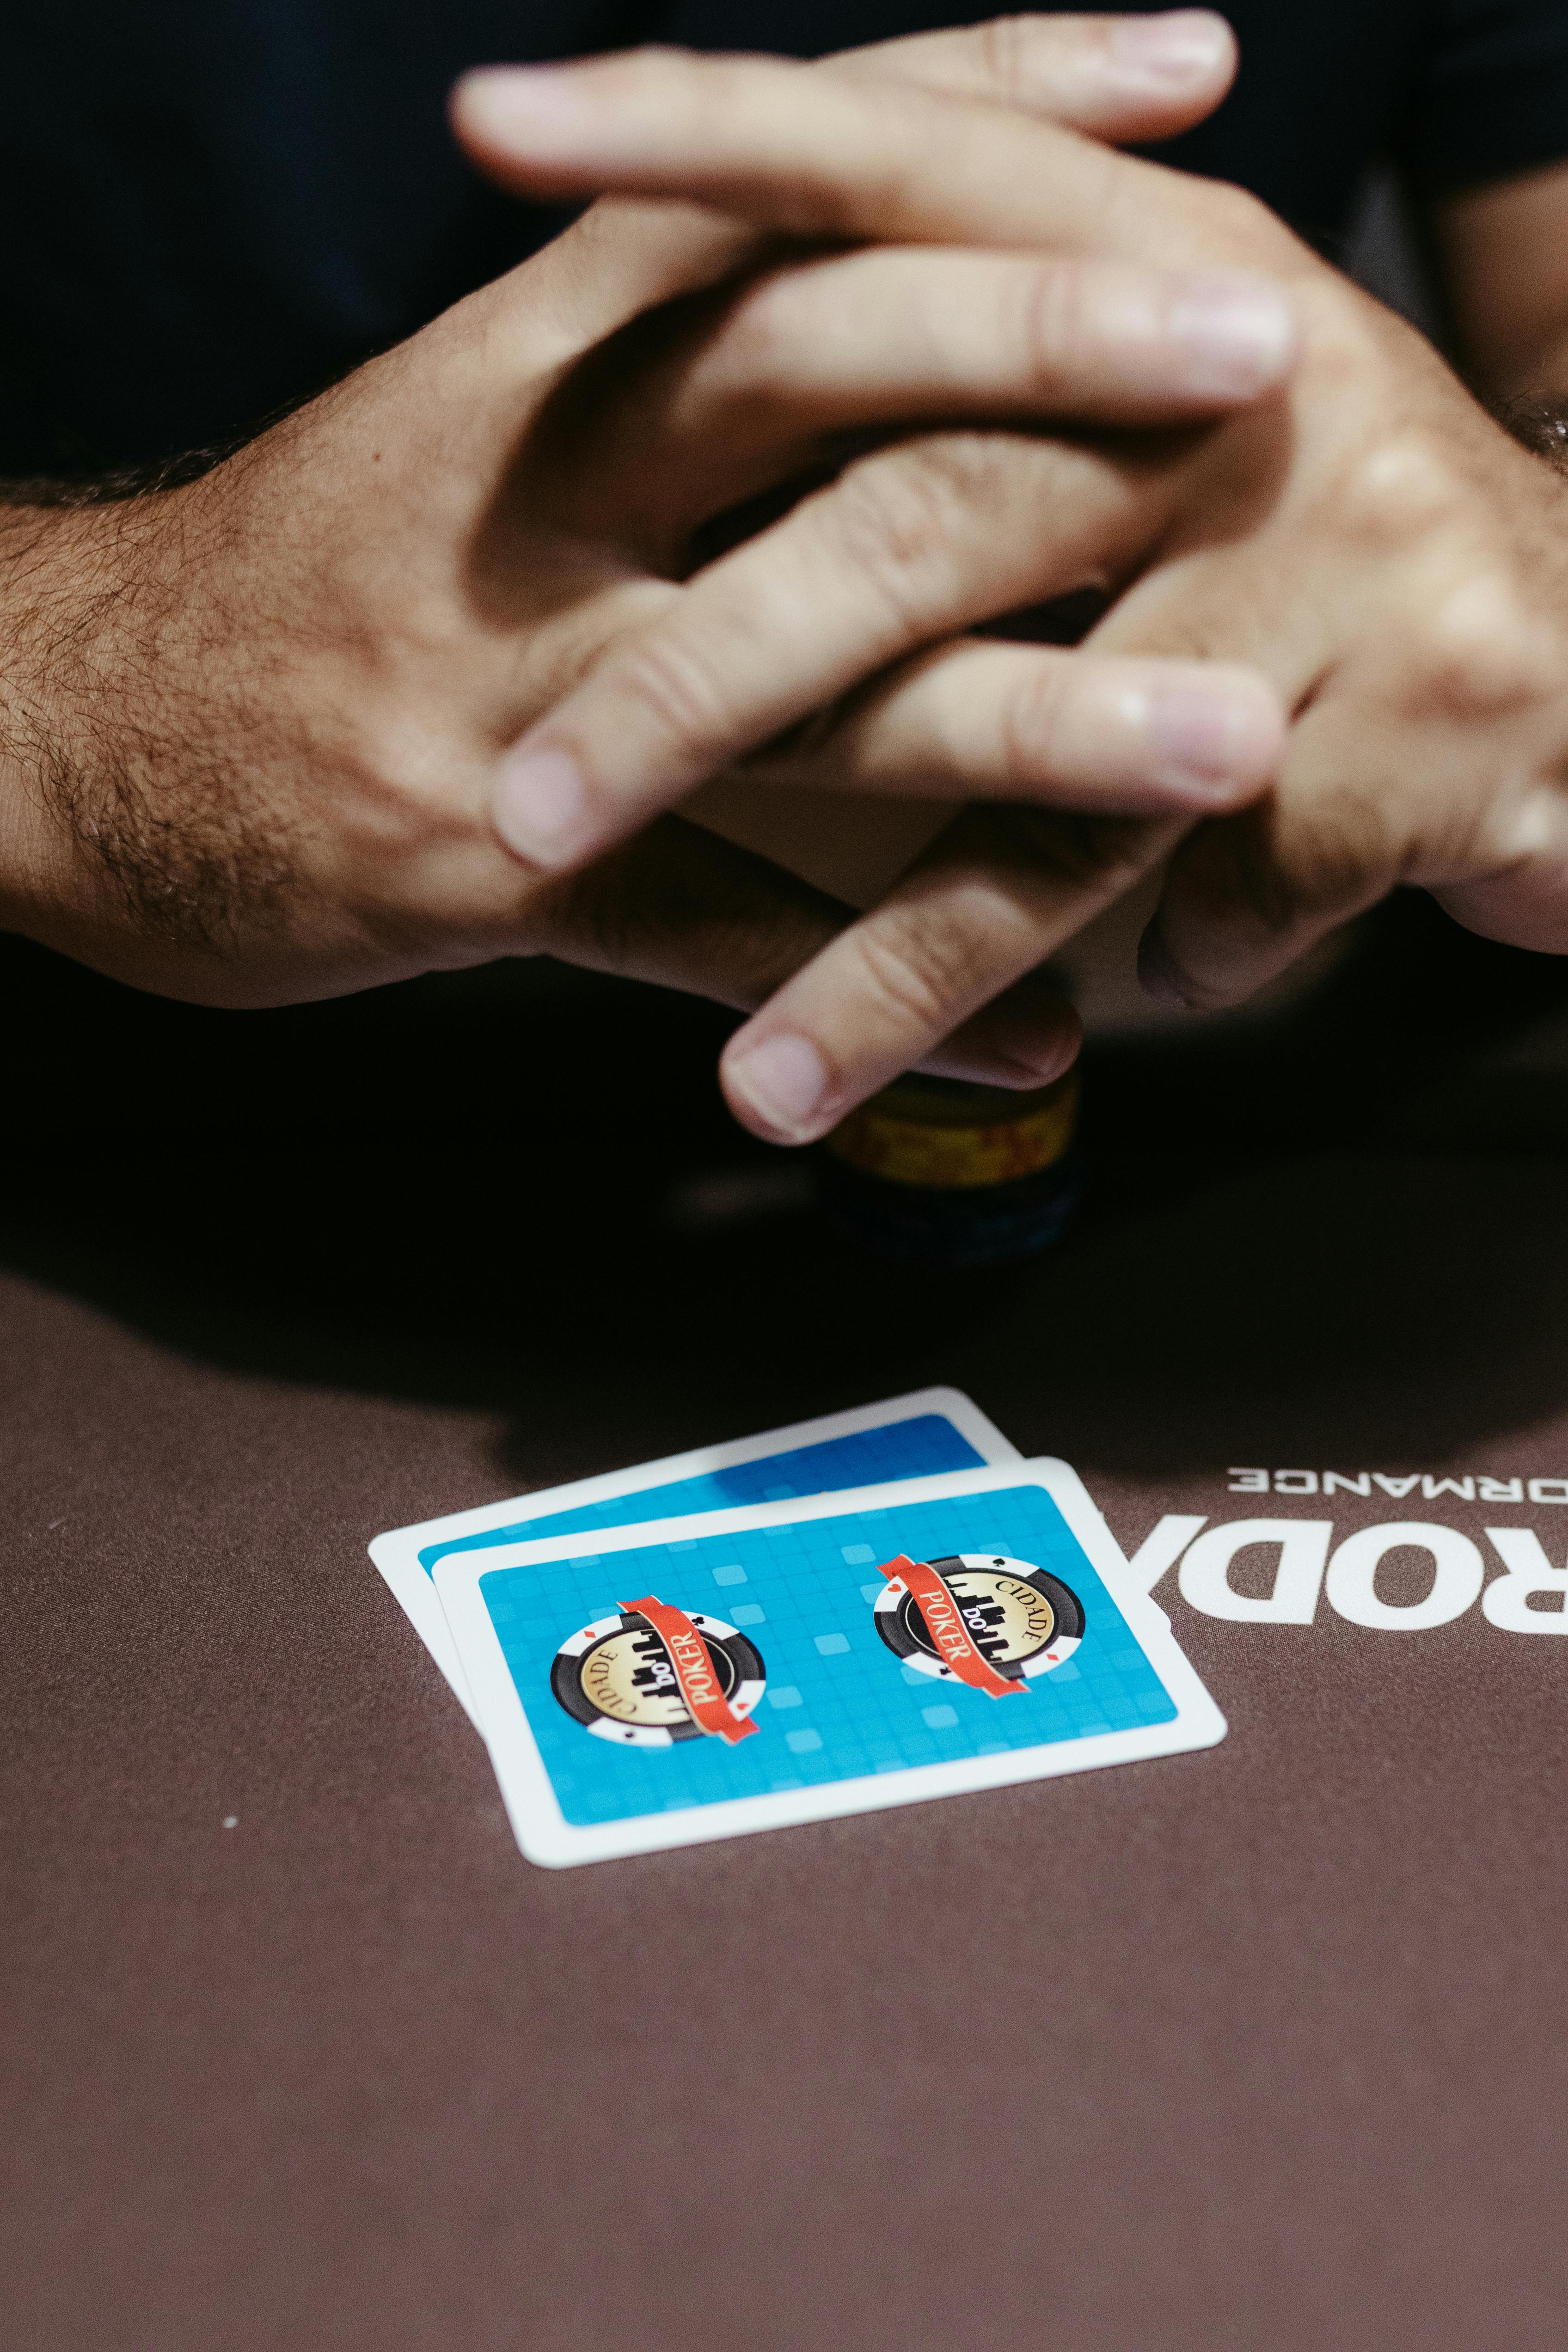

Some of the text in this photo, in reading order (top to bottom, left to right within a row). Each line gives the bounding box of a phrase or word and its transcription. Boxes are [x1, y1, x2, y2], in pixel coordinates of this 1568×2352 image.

[919, 1589, 972, 1662] POKER
[962, 1607, 988, 1631] DO
[995, 1580, 1047, 1643] CIDADE
[589, 1649, 637, 1716] CIDADE
[670, 1630, 719, 1705] POKER
